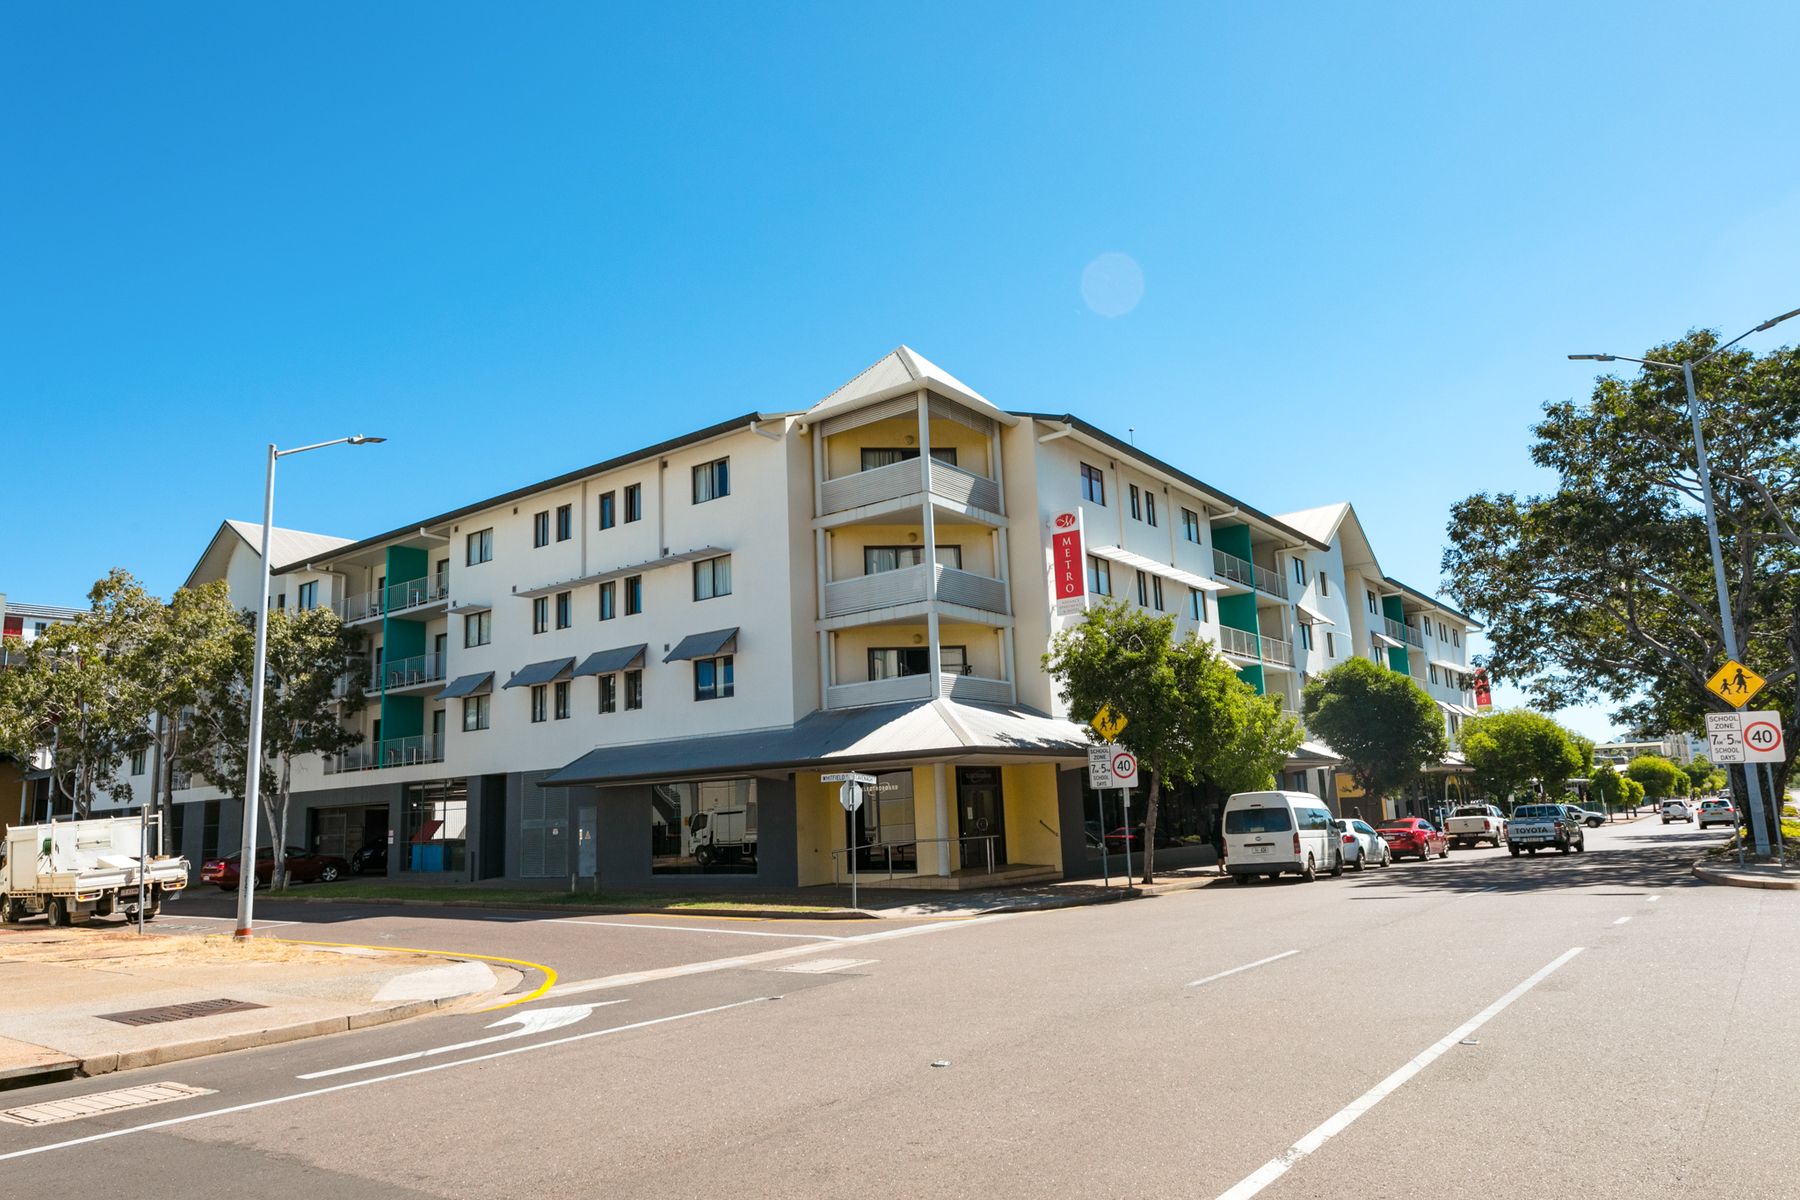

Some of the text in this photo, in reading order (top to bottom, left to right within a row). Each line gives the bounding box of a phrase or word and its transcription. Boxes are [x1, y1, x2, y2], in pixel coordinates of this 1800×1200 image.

[1062, 537, 1074, 593] METRO
[1752, 730, 1773, 743] 40
[1117, 760, 1131, 771] 40
